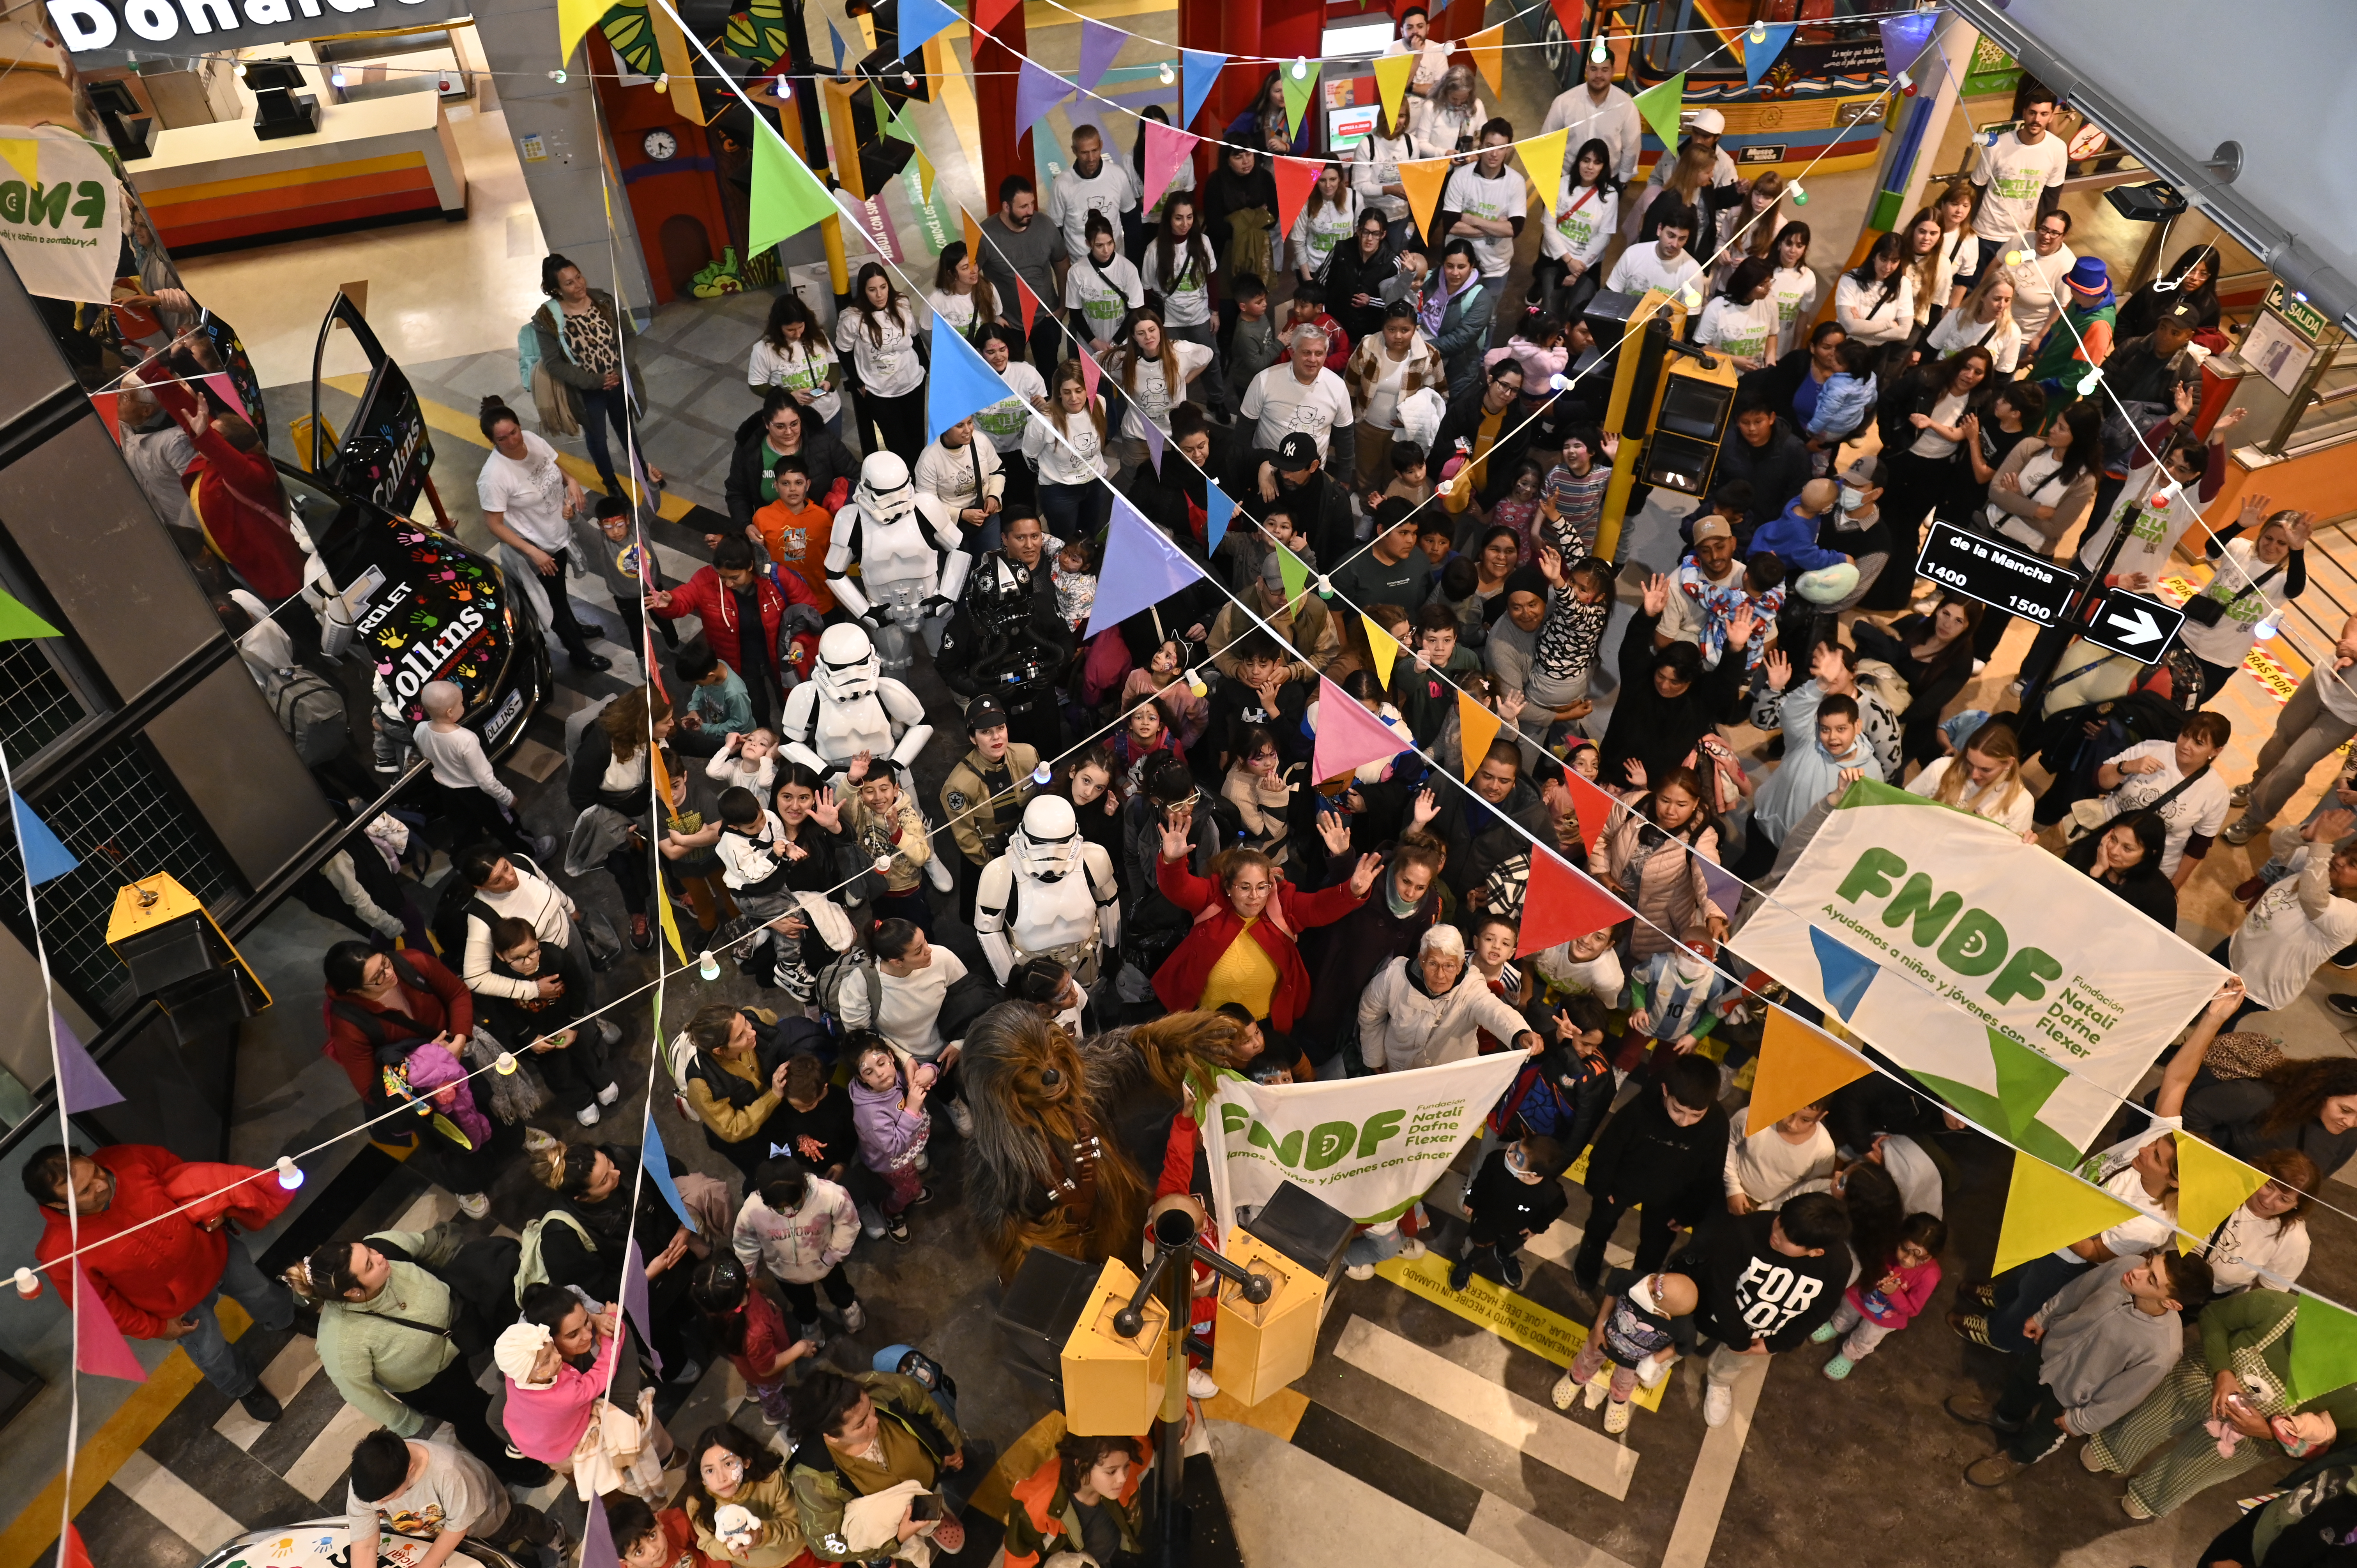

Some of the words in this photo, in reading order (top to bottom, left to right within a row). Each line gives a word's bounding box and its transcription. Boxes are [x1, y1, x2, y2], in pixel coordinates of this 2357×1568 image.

[869, 215, 883, 231] CON
[1576, 210, 1591, 218] NDF
[872, 231, 894, 259] DIBUJÁ
[2289, 302, 2320, 334] SALIDA
[372, 415, 419, 508] Collins
[1950, 535, 1970, 551] de
[1973, 543, 1988, 558] la
[1990, 551, 2053, 584] Mancha
[1927, 562, 1967, 586] 1400
[2170, 579, 2192, 597] POR
[2009, 595, 2050, 620] 1500
[2267, 675, 2292, 694] POR
[1835, 847, 2063, 1006] FNDF
[1822, 903, 1889, 950] Ayudamos
[1889, 948, 1900, 958] a
[1900, 955, 1936, 983] niños
[1936, 980, 1948, 992] y
[1944, 986, 1998, 1026] jóvenes
[2000, 1024, 2026, 1044] con
[2072, 976, 2124, 1014] Fundación
[1667, 1003, 1684, 1019] 10
[2060, 988, 2118, 1031] Natalí
[2046, 1002, 2101, 1045] Dafne
[2036, 1017, 2090, 1059] Flexer
[1412, 1106, 1463, 1123] Natalí
[1416, 1098, 1465, 1111] Fundación
[1221, 1102, 1405, 1171] FNDF
[1407, 1120, 1458, 1134] Dafne
[1405, 1133, 1456, 1147] Flexer
[1319, 1177, 1327, 1186] y
[1327, 1163, 1377, 1185] jóvenes
[1380, 1156, 1403, 1168] con
[1406, 1150, 1451, 1162] cáncer
[1402, 1267, 1440, 1292] LLAMADO
[1751, 1256, 1823, 1310] FOR
[1441, 1287, 1454, 1299] UN
[1454, 1293, 1485, 1314] RECIBE
[1486, 1309, 1491, 1318] Y
[1493, 1312, 1516, 1331] AUTO
[1499, 1301, 1522, 1318] DEBE
[1516, 1323, 1529, 1336] SU
